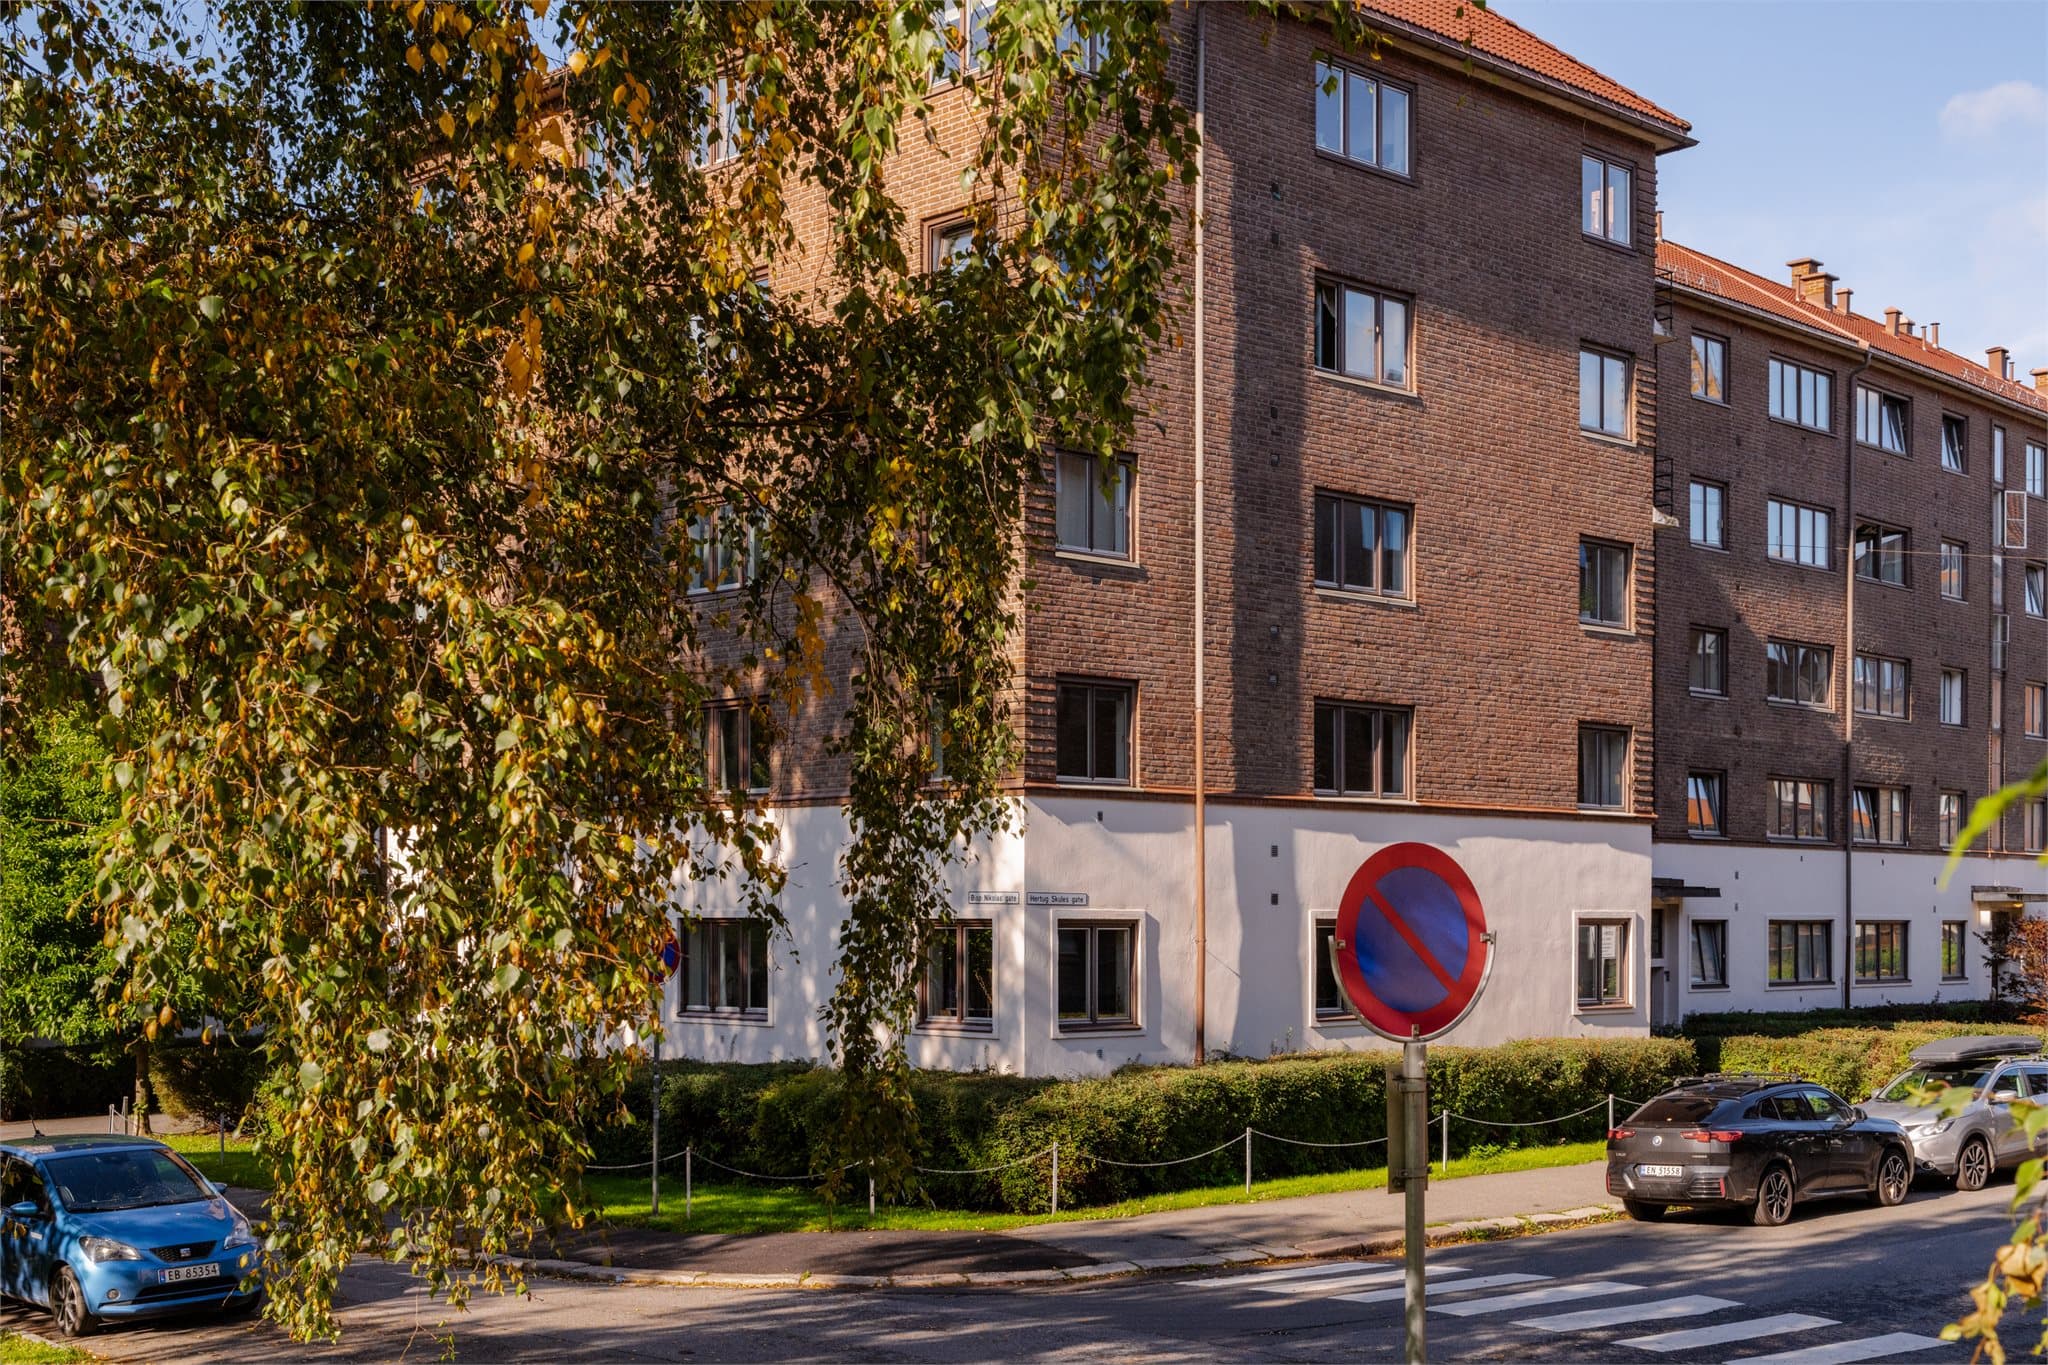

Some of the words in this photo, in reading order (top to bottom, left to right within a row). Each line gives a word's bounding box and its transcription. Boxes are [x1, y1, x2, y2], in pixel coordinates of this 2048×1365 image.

[1005, 895, 1017, 903] gate
[1030, 895, 1048, 904] Hertug
[1051, 895, 1069, 903] Skules
[1071, 896, 1084, 904] gate
[1647, 1166, 1656, 1174] EN
[168, 1270, 180, 1281] EB
[185, 1264, 217, 1279] 85354
